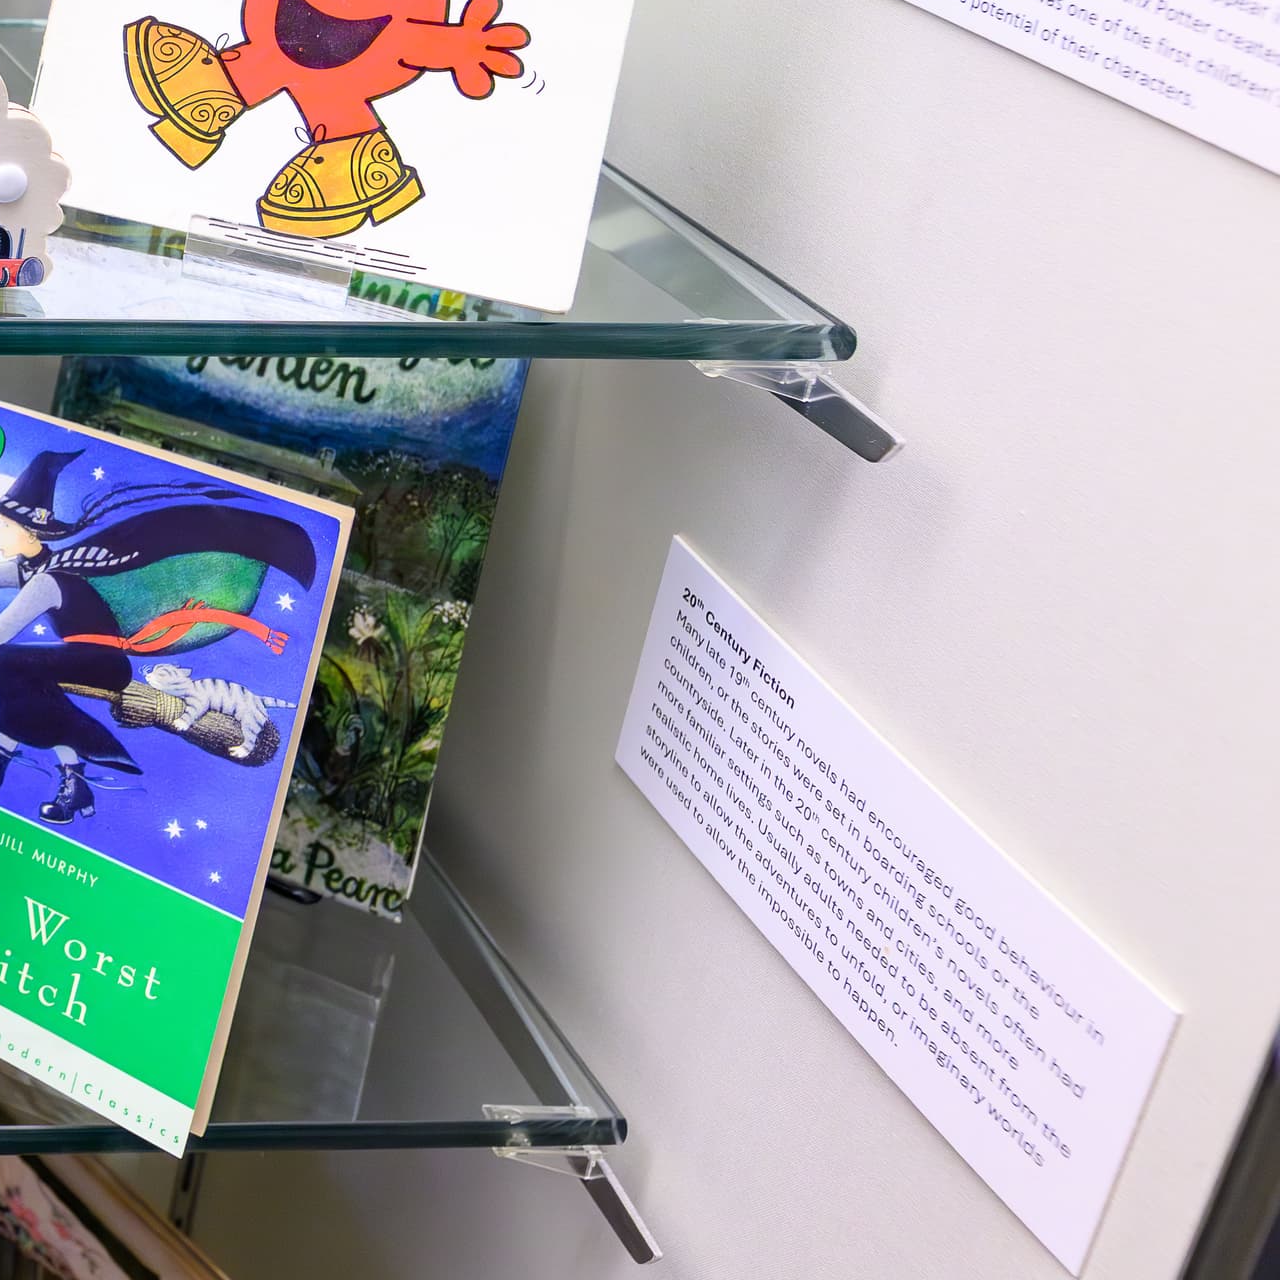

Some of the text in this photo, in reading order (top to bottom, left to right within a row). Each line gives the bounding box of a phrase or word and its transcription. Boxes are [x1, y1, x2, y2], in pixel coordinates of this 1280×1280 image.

[670, 636, 714, 689] children,
[677, 609, 704, 647] Many
[706, 640, 726, 669] late
[706, 611, 751, 664] Century
[752, 658, 795, 709] Fiction
[32, 849, 98, 887] MURPHY
[24, 895, 161, 1000] Worst
[758, 881, 825, 964] impossible
[844, 978, 900, 1047] happen.
